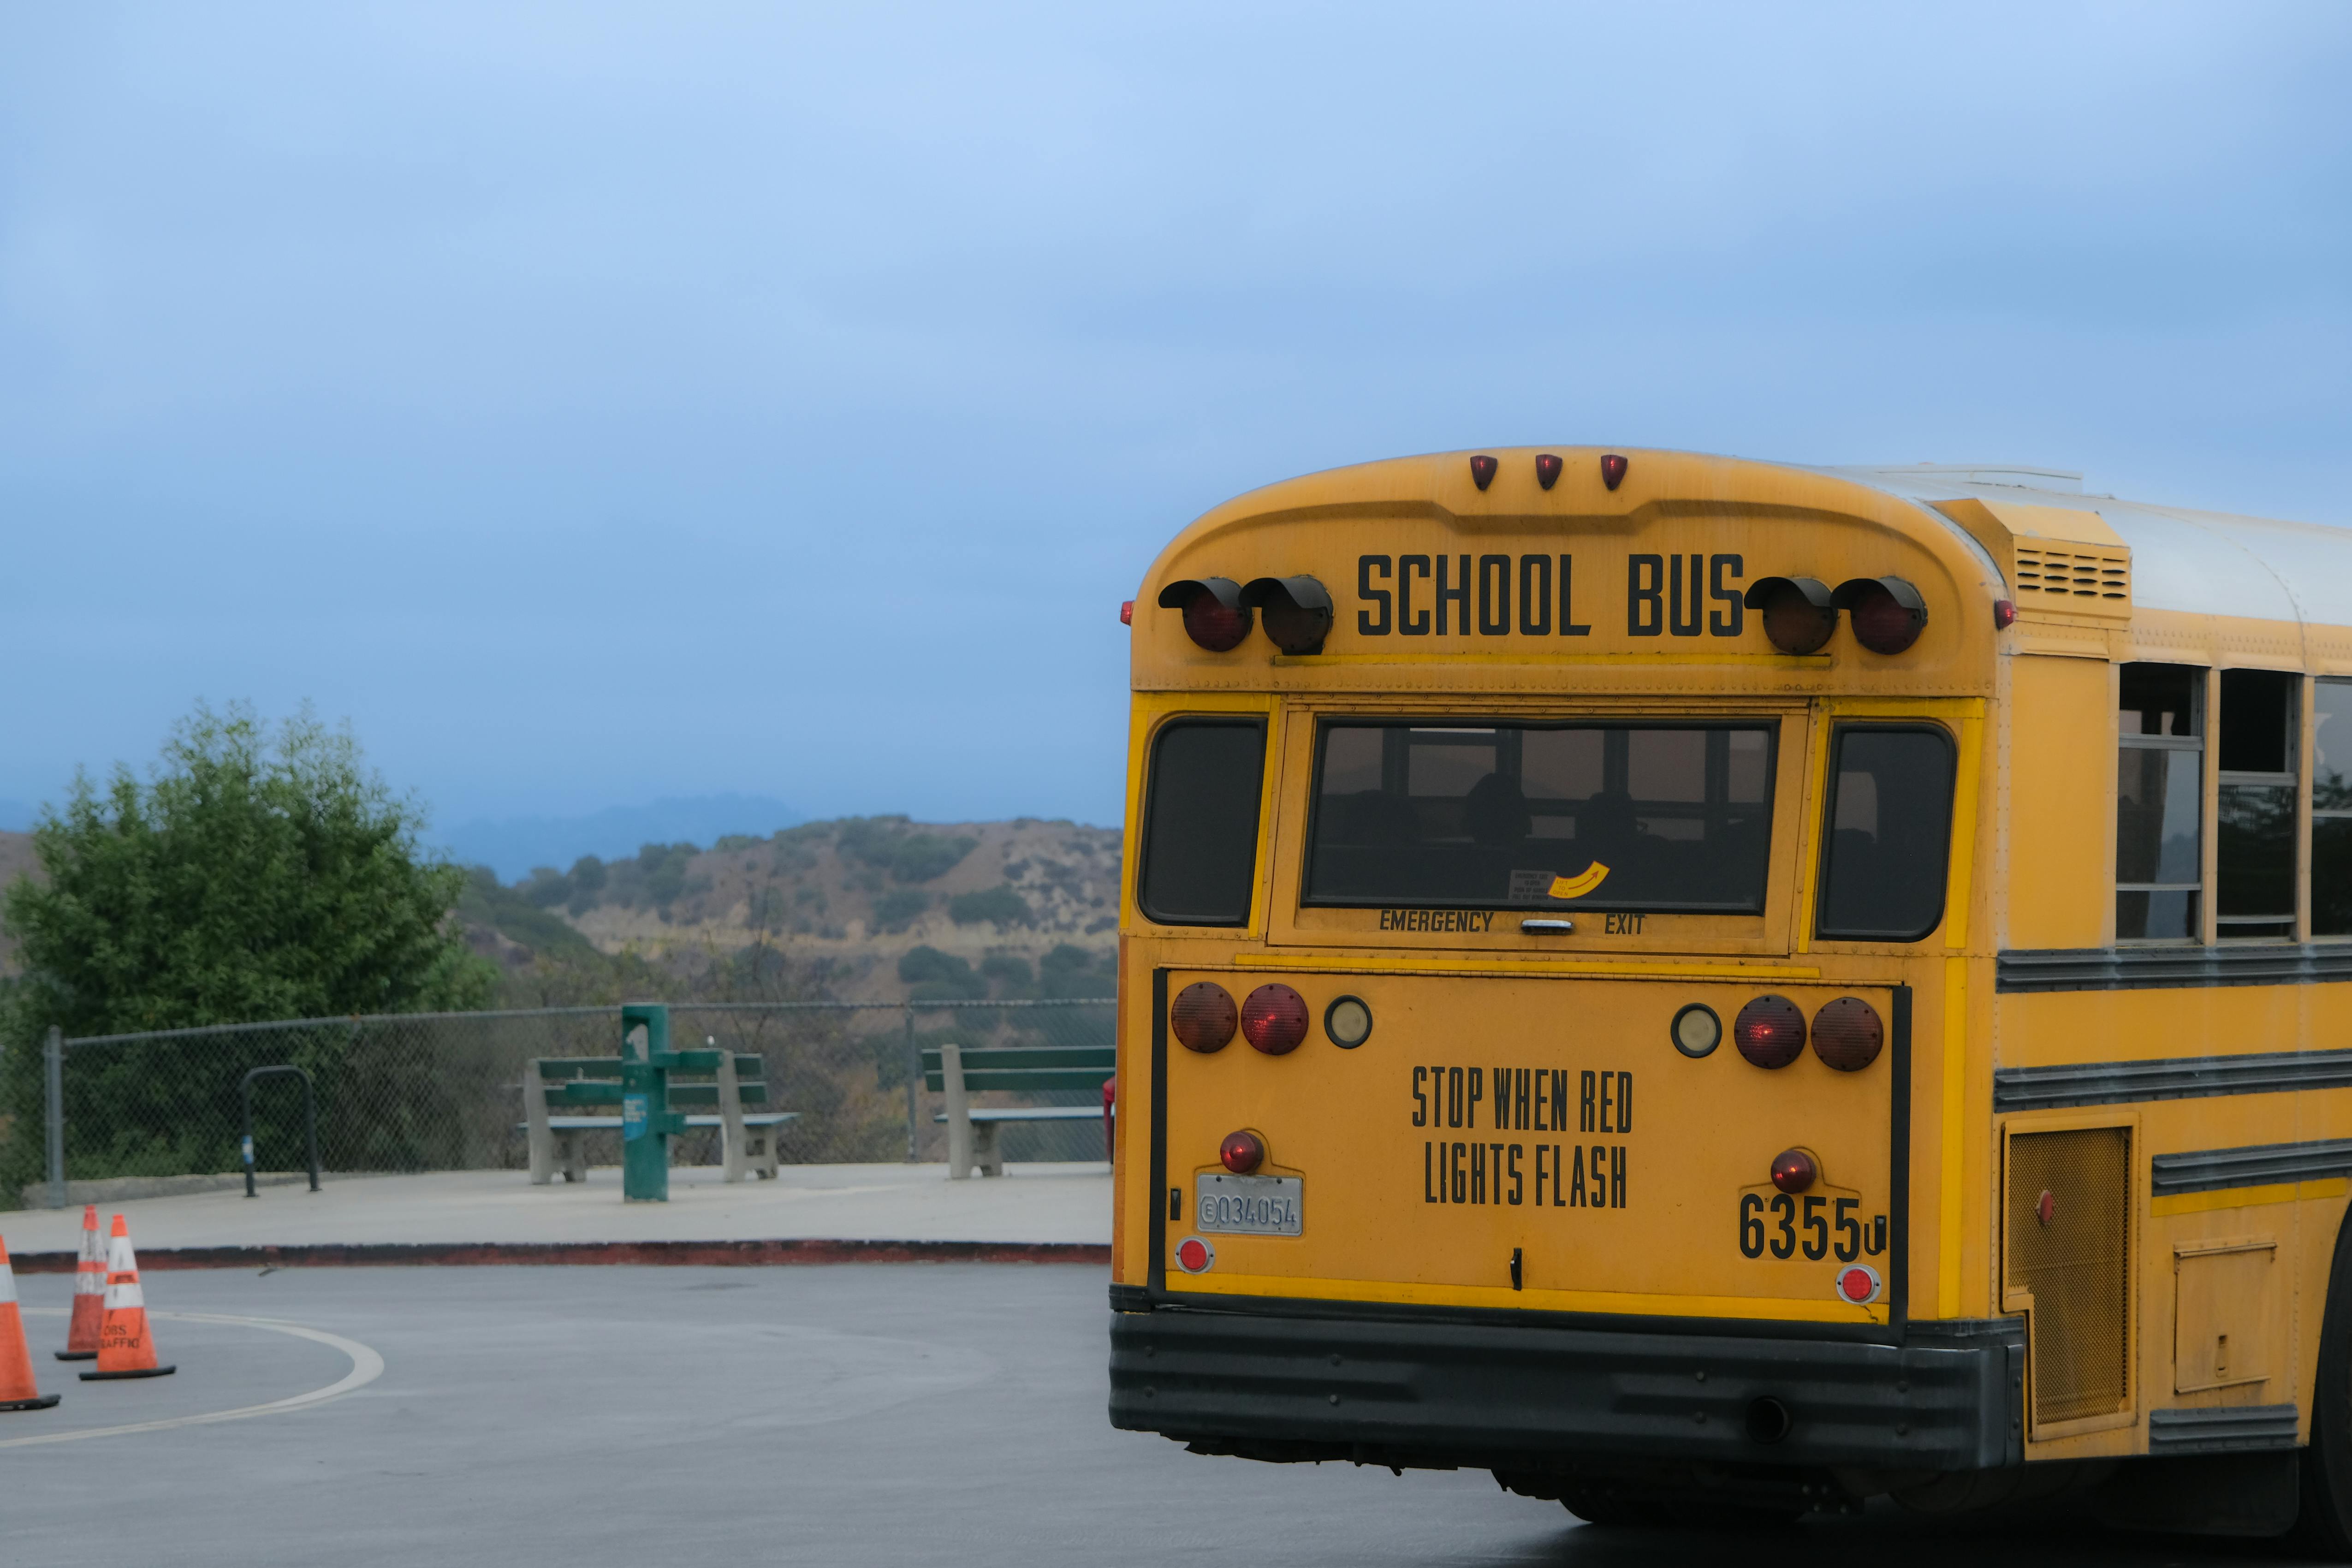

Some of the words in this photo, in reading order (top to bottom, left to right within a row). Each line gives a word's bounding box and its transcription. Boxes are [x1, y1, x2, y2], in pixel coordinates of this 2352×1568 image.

[1358, 554, 1592, 636] SCHOOL
[1627, 553, 1744, 637] BUS
[1379, 909, 1494, 933] EMERGENCY
[1604, 913, 1646, 935] EXIT
[1412, 1066, 1483, 1128] STOP
[1493, 1068, 1568, 1132] WHEN
[1580, 1070, 1633, 1134] RED
[1425, 1141, 1523, 1206] LIGHTS
[1535, 1144, 1626, 1209] FLASH
